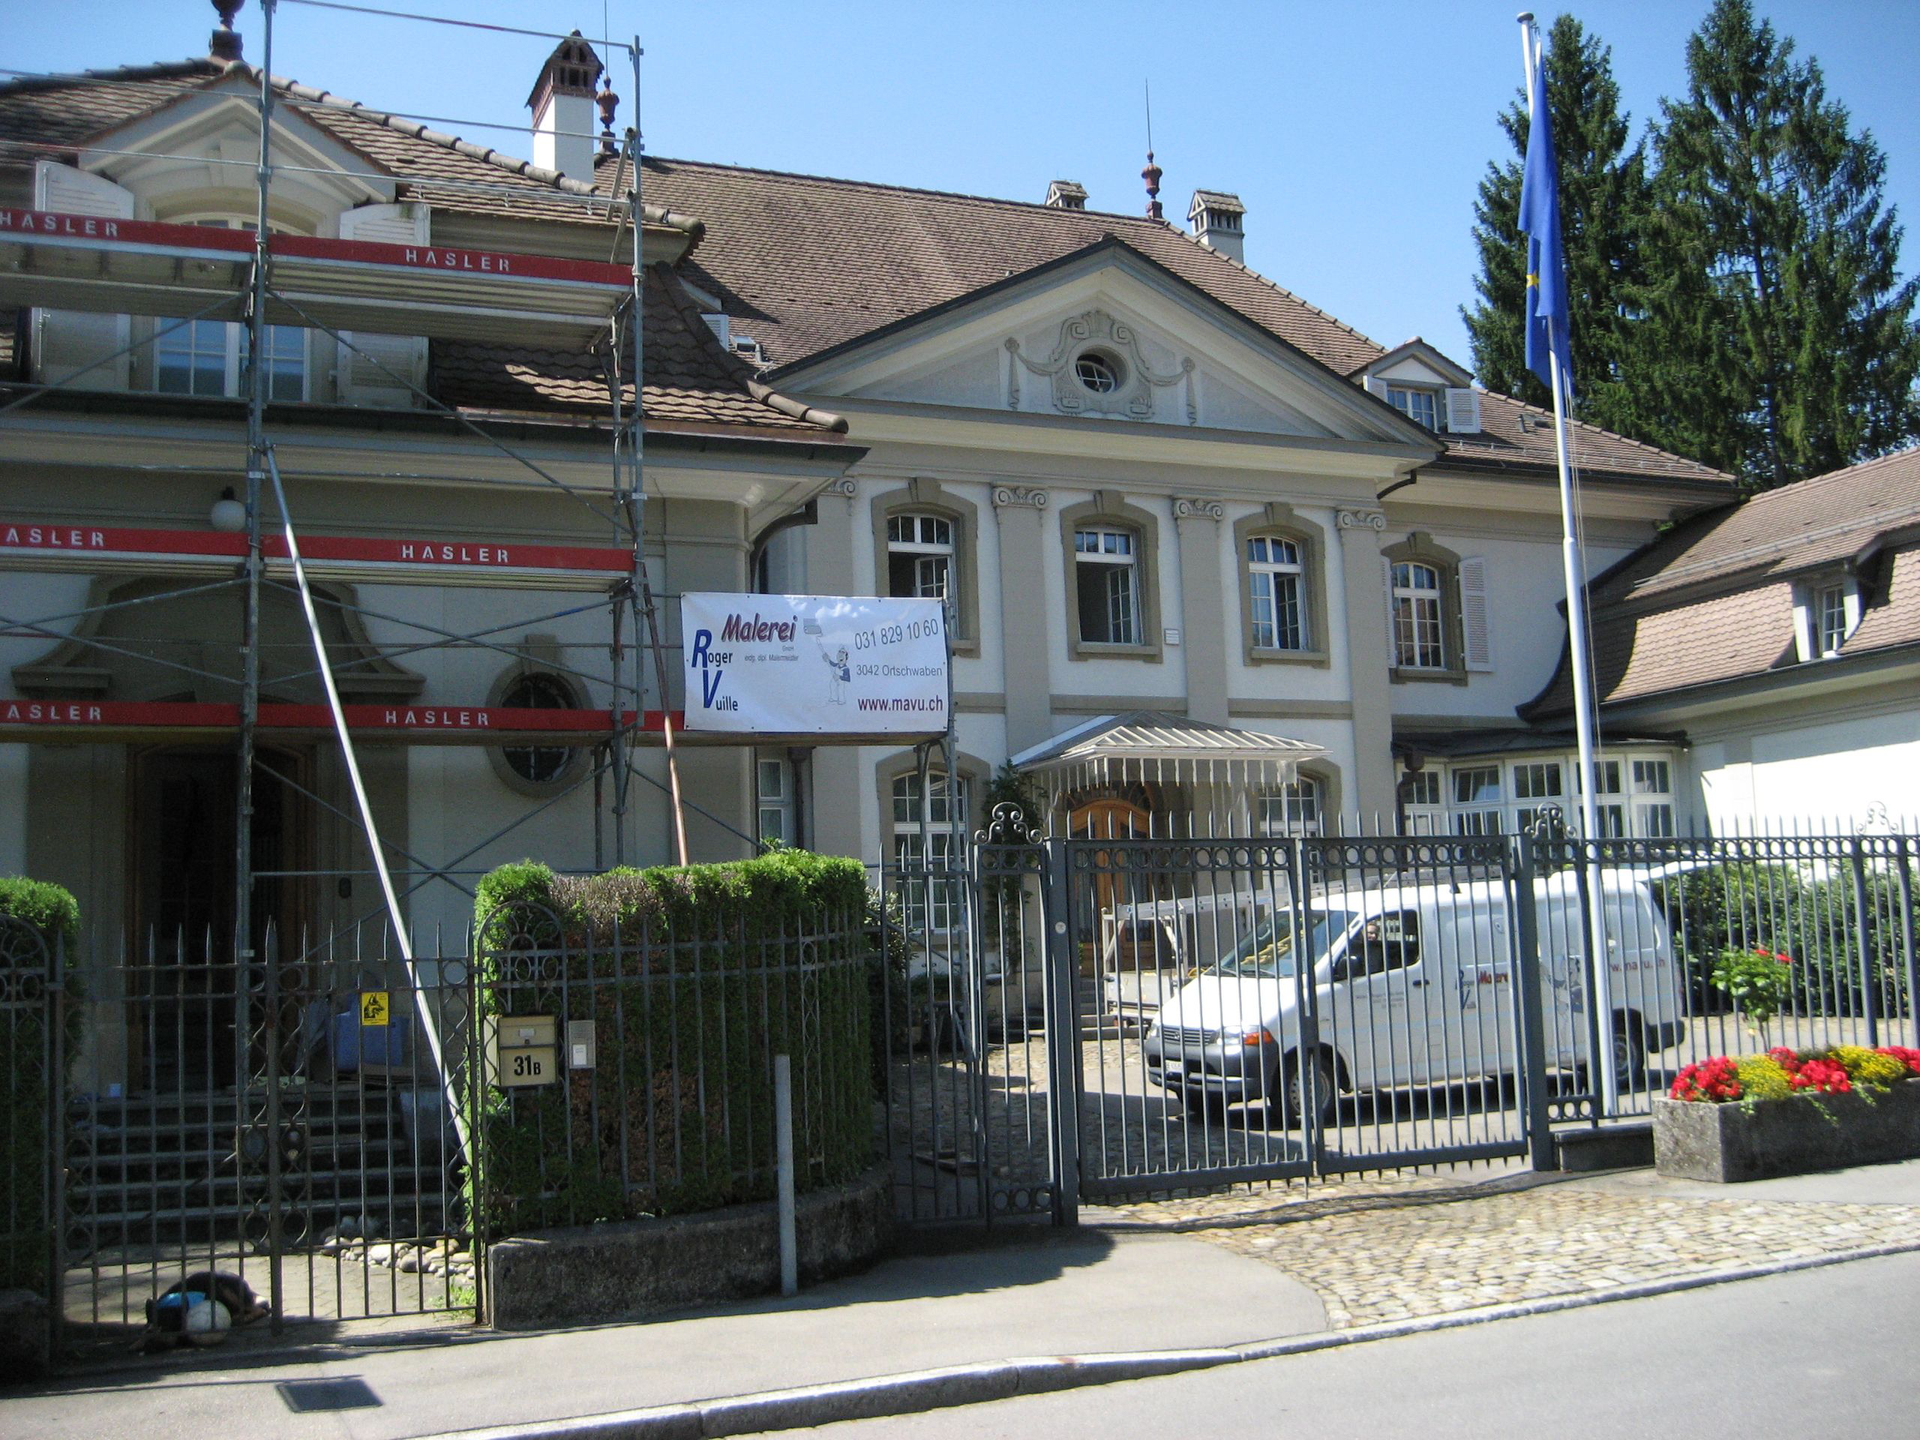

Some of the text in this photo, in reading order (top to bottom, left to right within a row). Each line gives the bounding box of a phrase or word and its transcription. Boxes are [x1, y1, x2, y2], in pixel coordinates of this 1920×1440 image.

[0, 211, 118, 237] HASLER
[405, 249, 510, 272] HASLER
[5, 528, 104, 547] ASLER
[401, 545, 509, 563] HASLER
[721, 612, 798, 643] Malerei
[854, 618, 939, 650] 031 829 10 60
[691, 629, 733, 668] Roger
[856, 664, 943, 676] 3042 Ortschwaben
[702, 669, 738, 711] Vuille
[7, 704, 101, 720] ASLER
[857, 694, 943, 711] www.mavu.ch
[385, 710, 489, 726] HASLER
[513, 1054, 541, 1076] 31B
